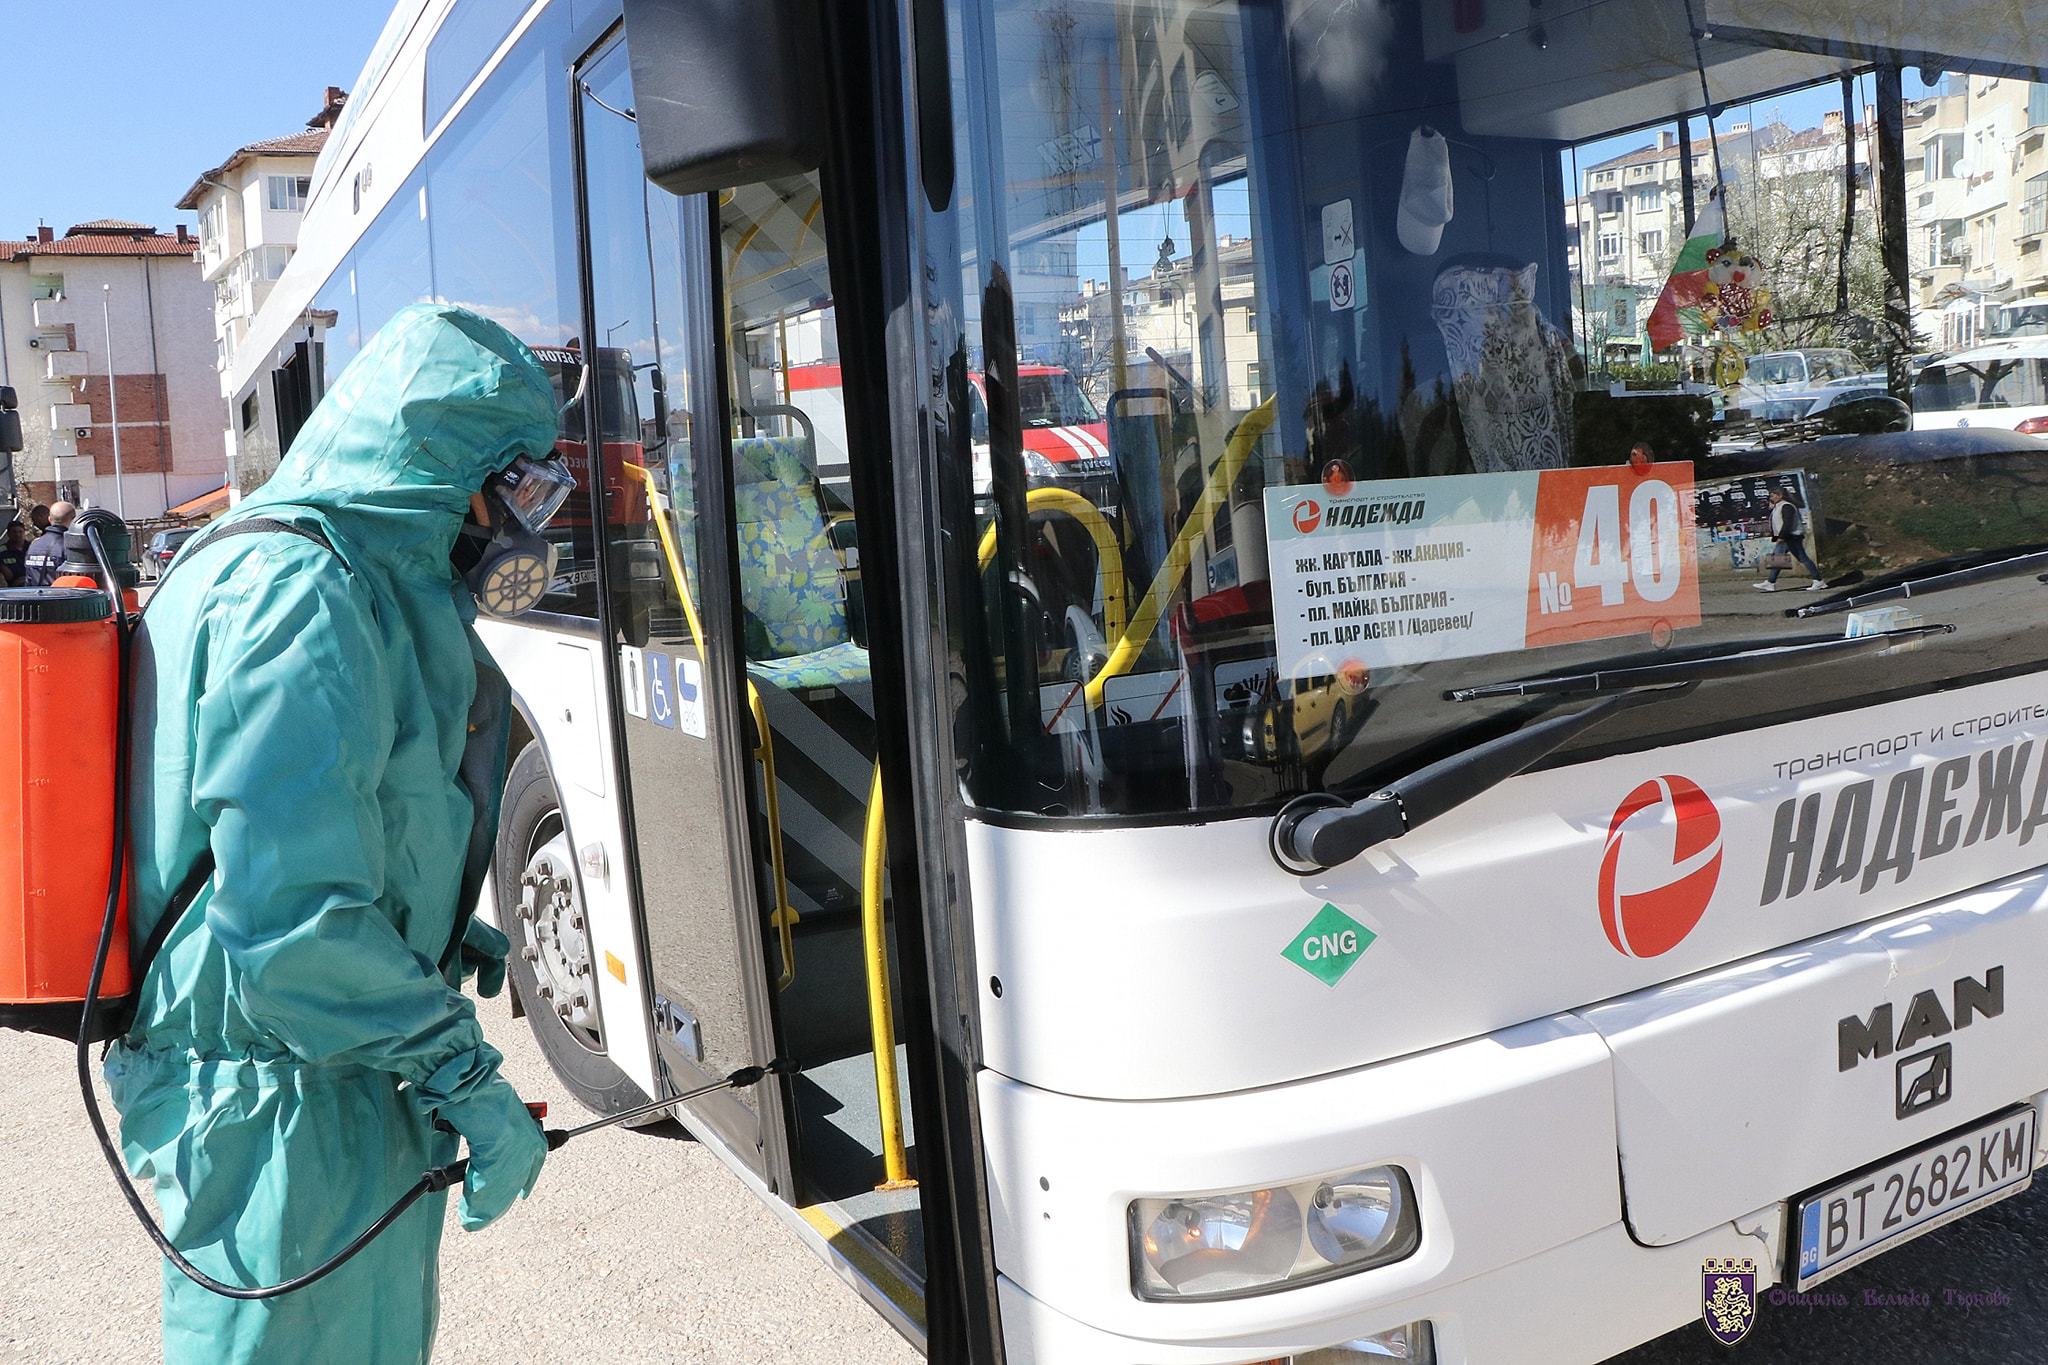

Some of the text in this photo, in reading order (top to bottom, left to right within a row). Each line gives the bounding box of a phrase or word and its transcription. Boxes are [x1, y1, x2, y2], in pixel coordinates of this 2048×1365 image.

[1325, 500, 1426, 528] НАДЕЖДА
[1574, 479, 1681, 607] 40
[1322, 549, 1383, 571] КАРТАЛА
[1305, 580, 1335, 598] бул.
[1337, 571, 1406, 594] БЪЛГАРИЯ
[1308, 607, 1330, 622] пл.
[1332, 597, 1379, 619] МАЙКА
[1380, 590, 1448, 614] БЪЛГАРИЯ
[1310, 632, 1332, 647] пл.
[1334, 625, 1360, 645] ЦАР
[1363, 620, 1396, 640] АСЕН
[1407, 611, 1474, 636] /Царевец/
[1952, 704, 2048, 736] строите
[1303, 929, 1357, 961] CNG
[1838, 965, 2005, 1073] MAN
[1881, 1145, 1971, 1230] 2682
[1978, 1121, 2026, 1189] KM
[1802, 1246, 1818, 1267] BG
